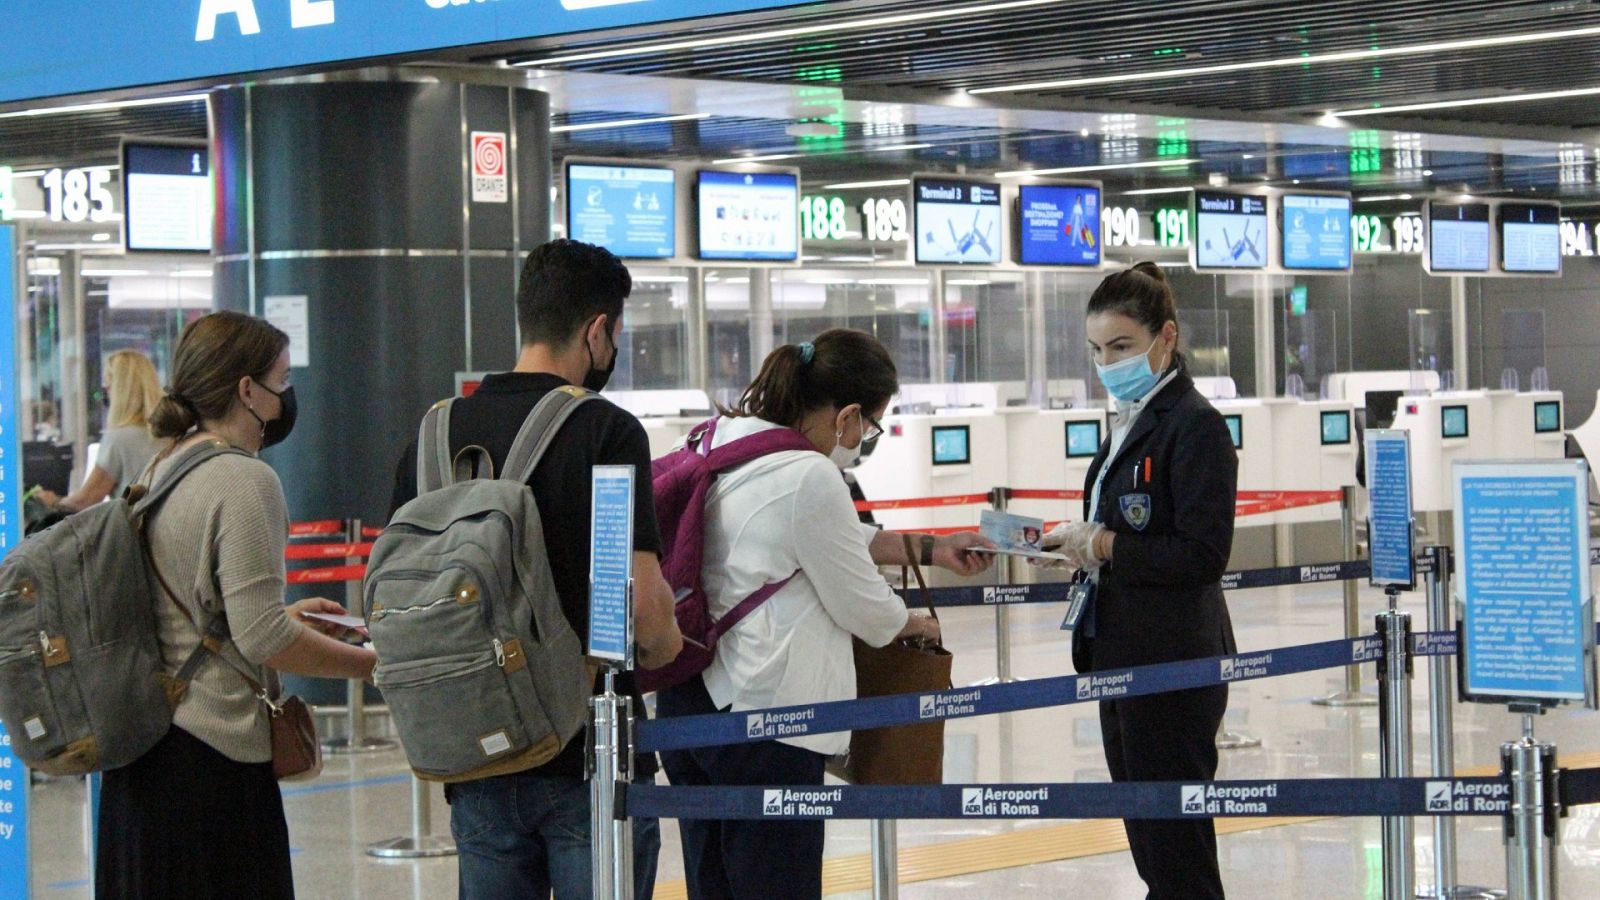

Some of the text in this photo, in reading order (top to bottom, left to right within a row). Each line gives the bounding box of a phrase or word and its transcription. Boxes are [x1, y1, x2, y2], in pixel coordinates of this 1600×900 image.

[43, 168, 113, 222] 185
[920, 186, 962, 200] Terminal 3
[1200, 198, 1229, 210] Terminal
[800, 197, 846, 240] 188
[863, 198, 907, 241] 189
[1101, 207, 1139, 247] 190
[1157, 208, 1189, 247] 191
[1351, 215, 1381, 251] 192
[1393, 216, 1424, 252] 193
[1560, 222, 1587, 256] 194
[1416, 556, 1435, 566] oporti
[1311, 564, 1340, 573] Aeroporti
[1221, 572, 1242, 582] oporti
[1320, 572, 1337, 580] Roma
[995, 585, 1029, 595] Aeroporti
[1428, 633, 1457, 645] Aeropo
[1234, 653, 1272, 667] Aeroporti
[1091, 672, 1133, 686] Aeroporti
[1235, 666, 1266, 678] di Roma
[935, 690, 981, 705] Aeroporti
[1091, 684, 1127, 697] di Roma
[765, 708, 815, 724] Aeroporti
[936, 703, 974, 717] di Roma
[765, 723, 808, 736] di Roma
[784, 789, 842, 804] Aeroporti
[984, 787, 1048, 803] Aeroporti
[1206, 784, 1277, 800] Aeroporti
[1453, 781, 1509, 798] Aeropo
[766, 805, 781, 813] ADR
[784, 803, 833, 815] di Roma
[964, 804, 982, 813] ADR
[985, 803, 1039, 815] di Roma
[1207, 801, 1267, 813] di Roma
[1474, 797, 1509, 811] Rom
